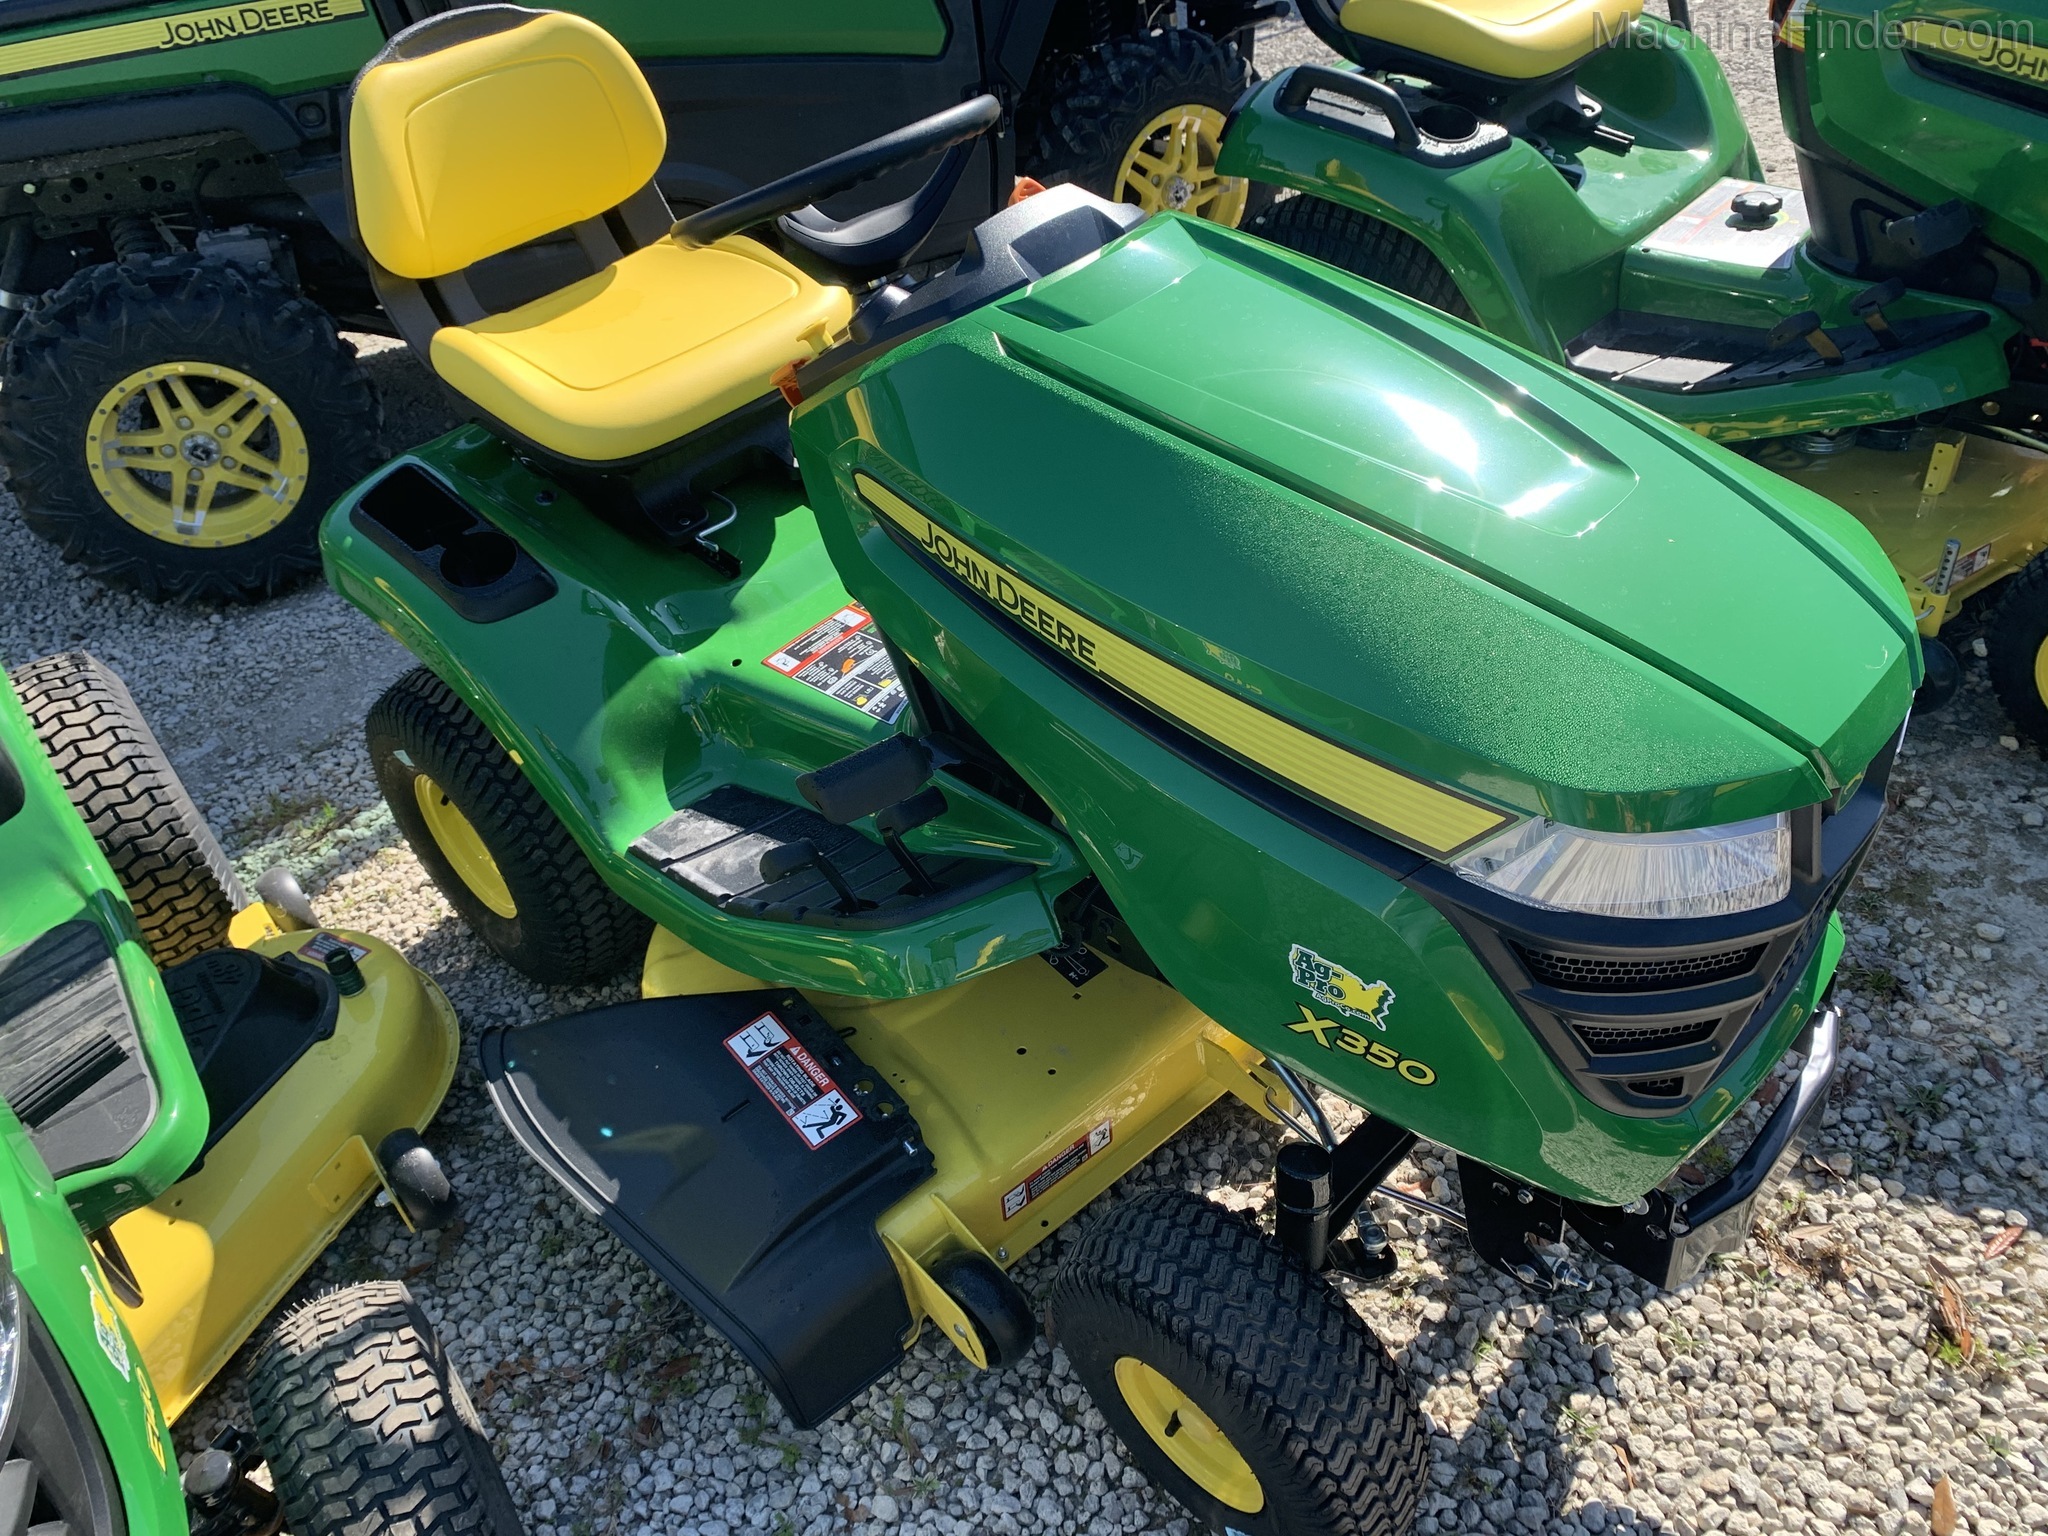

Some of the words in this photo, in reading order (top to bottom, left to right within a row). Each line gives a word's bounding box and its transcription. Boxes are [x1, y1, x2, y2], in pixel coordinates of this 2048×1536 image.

[161, 15, 236, 46] JOHN
[239, 0, 332, 31] DEERE
[921, 522, 991, 594] JOHN
[996, 573, 1097, 667] DEERE
[1297, 968, 1345, 998] Pro
[1284, 1002, 1437, 1086] X350
[797, 1053, 829, 1087] DANGER
